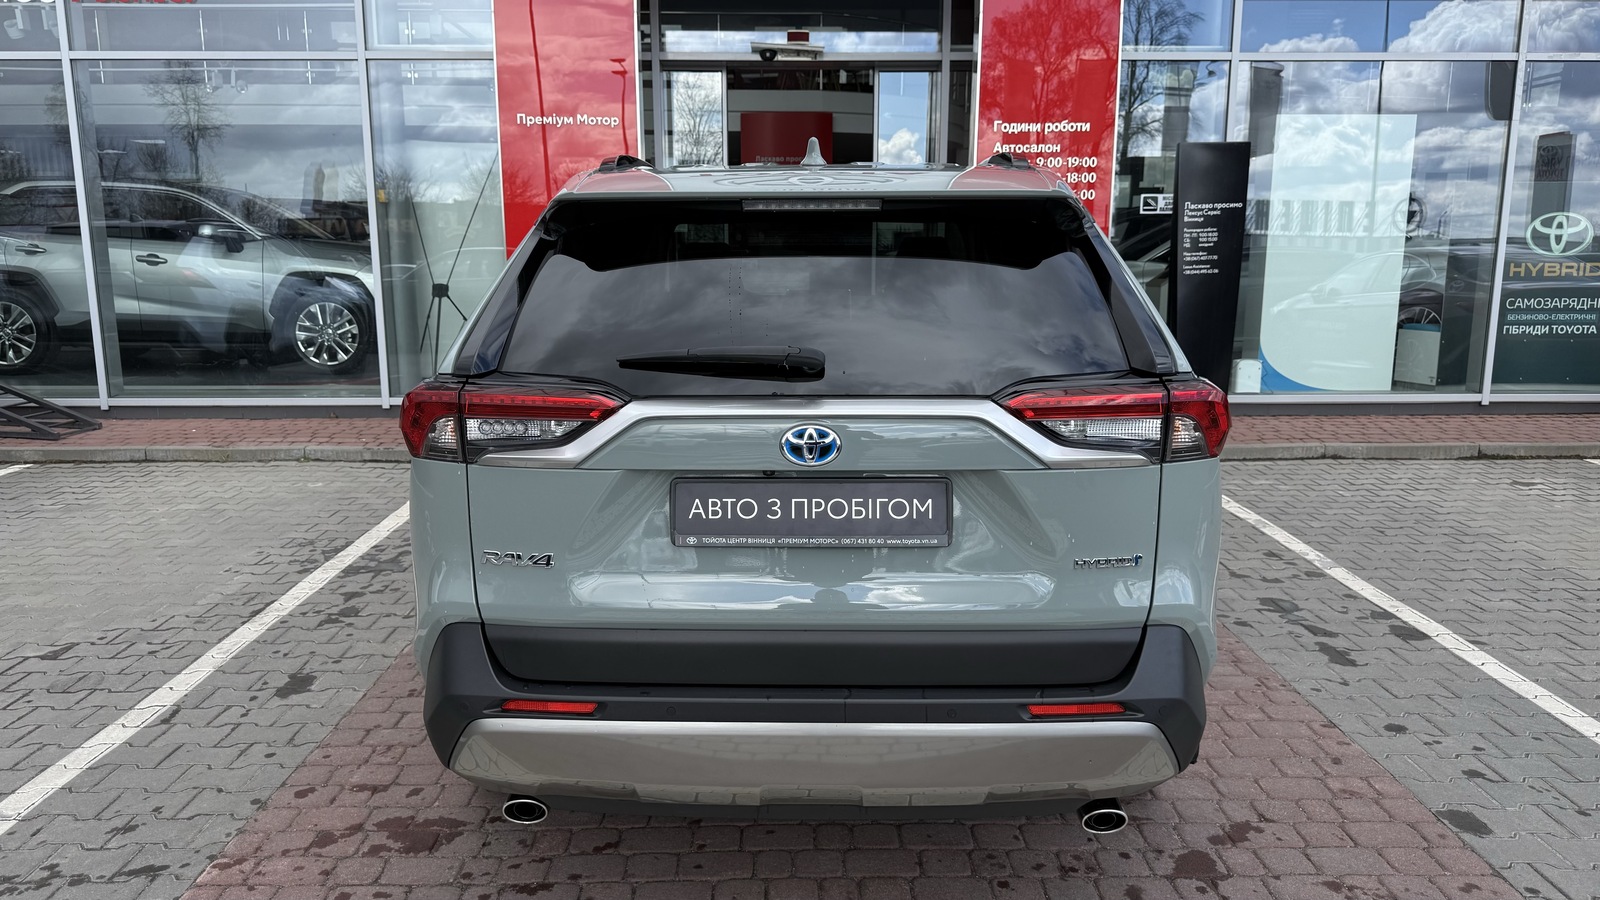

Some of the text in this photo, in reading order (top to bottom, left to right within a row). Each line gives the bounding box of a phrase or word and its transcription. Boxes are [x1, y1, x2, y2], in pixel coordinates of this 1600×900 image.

[516, 113, 619, 128] Преміум Мотор
[993, 120, 1091, 135] Години роботи
[993, 142, 1061, 153] Автосалон
[1036, 157, 1097, 168] 9:00-19:00
[1214, 202, 1243, 210] просимо
[1509, 262, 1600, 277] HYBRID
[1503, 325, 1597, 335] ГІБРИДИ TOYOTA
[688, 498, 758, 520] АВТО
[791, 498, 933, 520] ПРОБІГОМ
[702, 536, 726, 544] ТОЙОТА
[727, 537, 747, 545] ЦЕНТР
[748, 537, 776, 545] ВІННИЦЯ
[482, 549, 555, 568] RAV4
[1074, 556, 1133, 569] HYBRID
